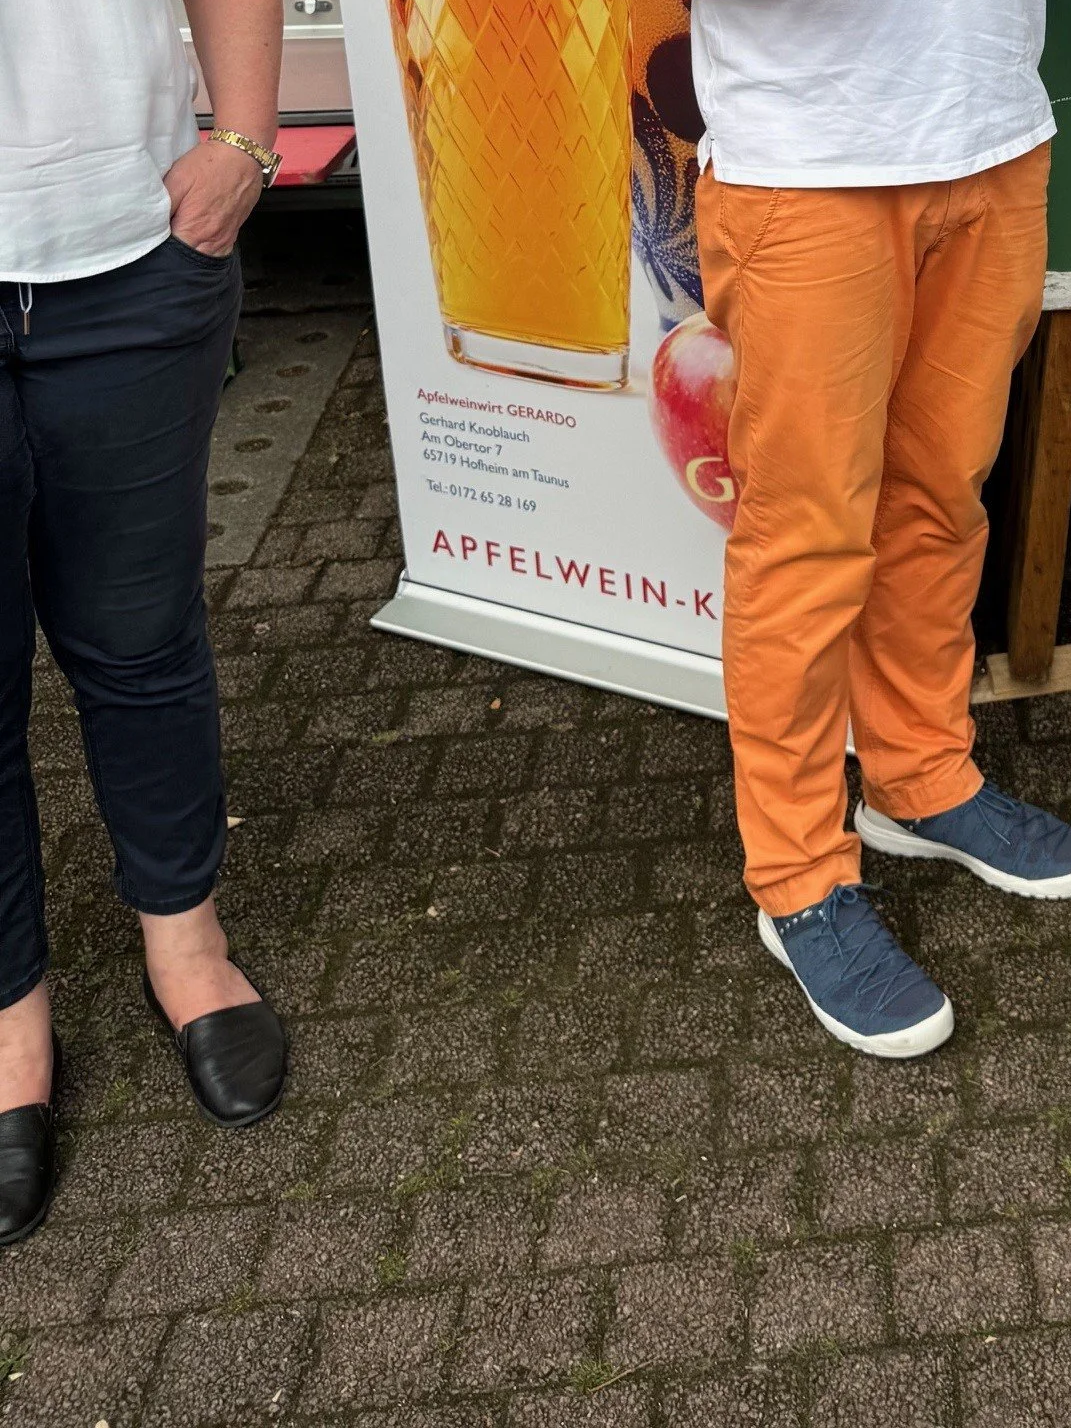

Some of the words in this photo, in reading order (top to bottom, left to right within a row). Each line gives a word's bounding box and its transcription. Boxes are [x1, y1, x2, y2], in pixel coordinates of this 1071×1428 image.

[417, 388, 503, 414] Apfelweinwirt
[507, 404, 577, 428] GERARDO
[419, 412, 465, 432] Gerhard
[469, 421, 530, 442] Knoblauch
[421, 431, 441, 444] Am
[444, 435, 492, 455] Obertor
[495, 444, 502, 456] 7
[423, 448, 457, 464] 65719
[460, 455, 509, 476] Hofheim
[512, 468, 530, 480] am
[531, 468, 570, 488] Taunus
[685, 456, 736, 502] G
[480, 491, 494, 504] 65
[499, 494, 512, 507] 28
[517, 498, 537, 512] 169
[432, 529, 718, 620] APFELWEIN-K
